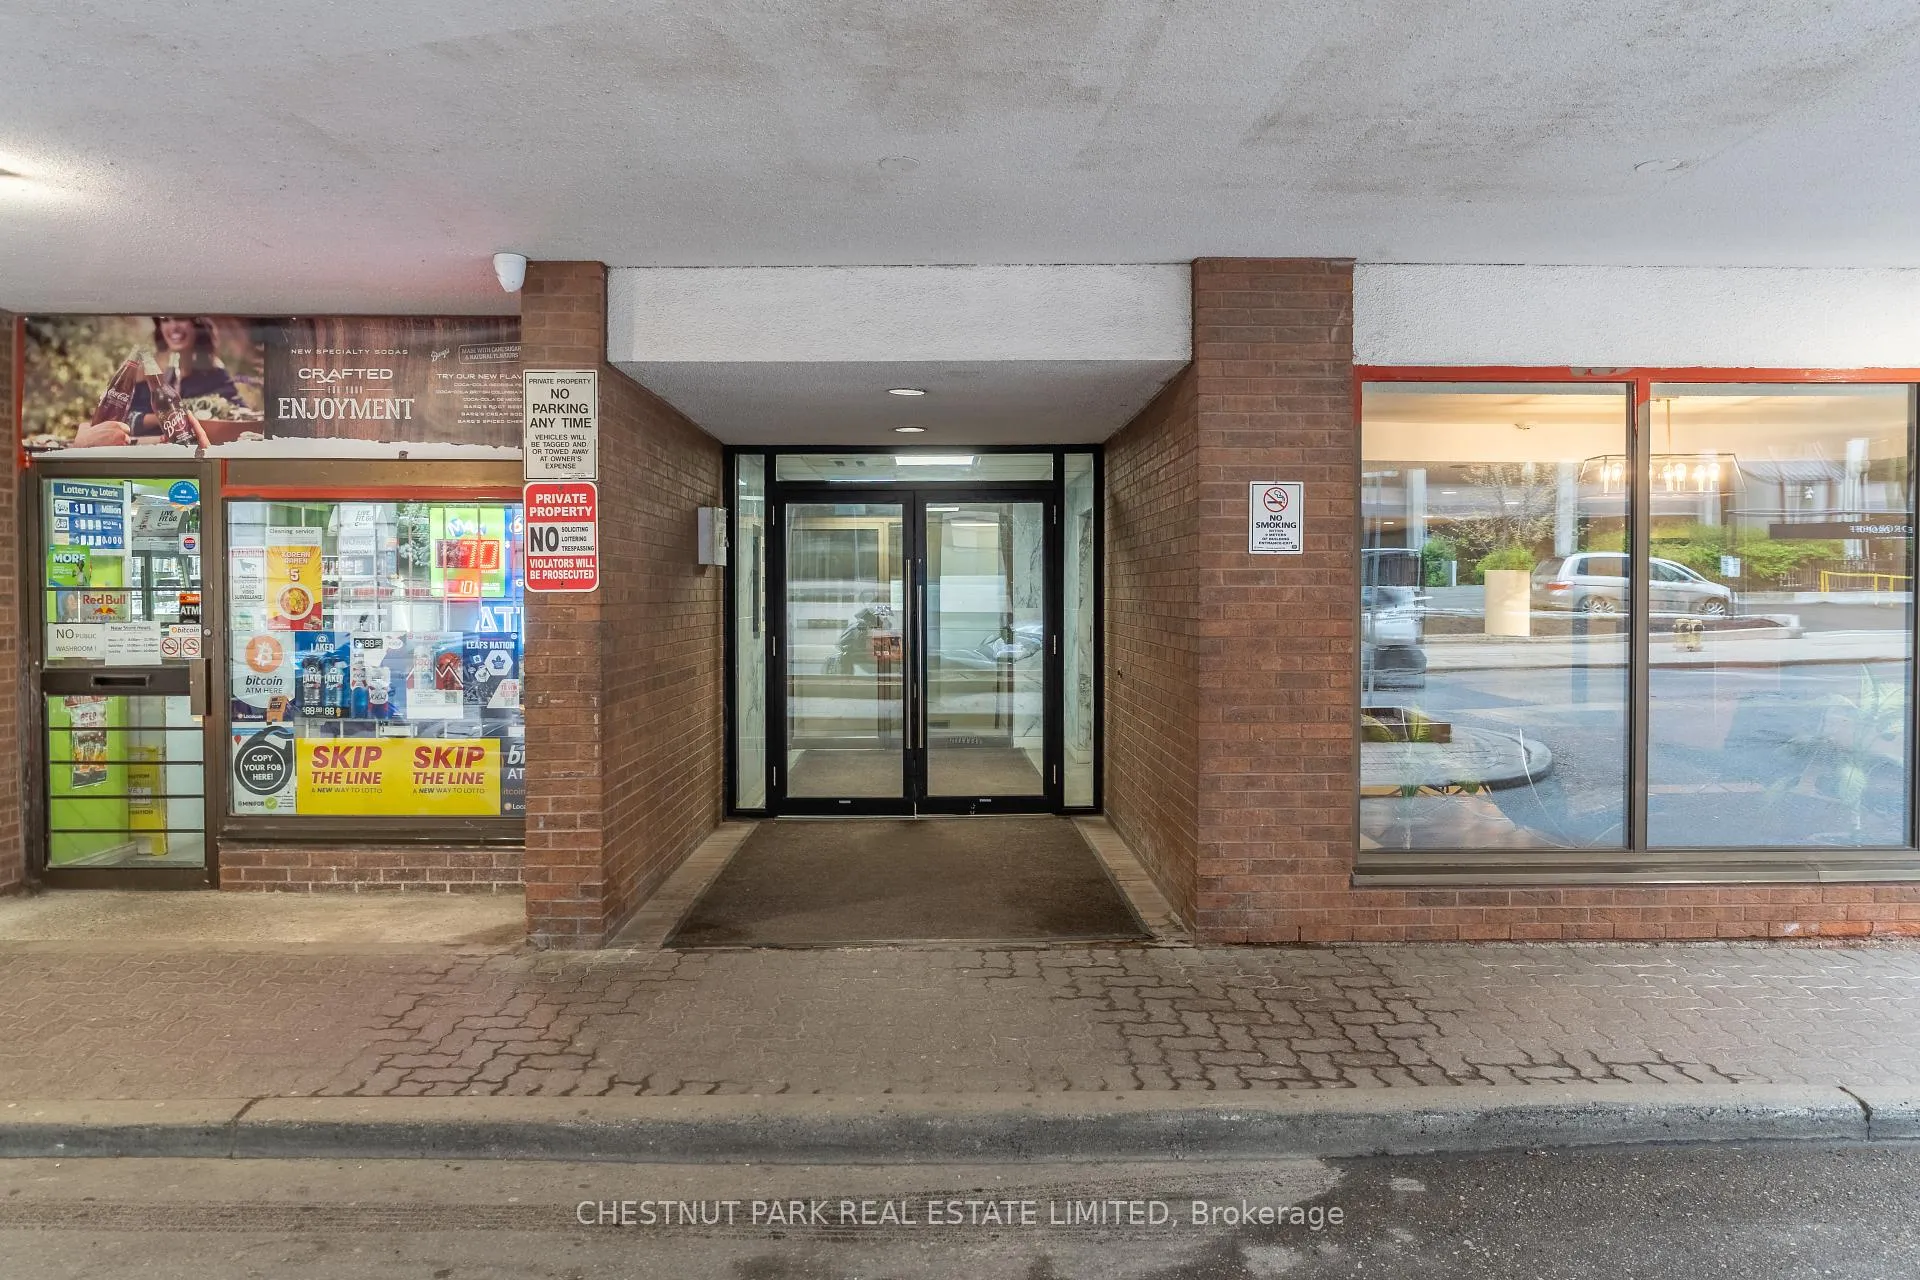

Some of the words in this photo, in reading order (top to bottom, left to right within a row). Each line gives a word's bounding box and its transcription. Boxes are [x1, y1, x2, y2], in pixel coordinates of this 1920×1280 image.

[298, 368, 394, 383] CRAFTED
[550, 388, 570, 400] NO
[277, 398, 415, 420] ENJOYMENT
[532, 403, 589, 415] PARKING
[529, 417, 557, 429] ANY
[561, 417, 592, 429] TIME
[62, 485, 90, 497] Lottery
[535, 493, 587, 504] PRIVATE
[529, 506, 593, 517] PROPERTY
[529, 526, 560, 553] NO
[529, 559, 574, 568] VIOLATORS
[576, 558, 594, 568] WILL
[529, 570, 541, 580] BE
[542, 569, 594, 580] PROSECUTED
[83, 594, 104, 605] Red
[106, 594, 126, 605] Bull
[180, 605, 199, 615] ATM
[475, 606, 524, 632] AT
[56, 629, 74, 639] NO
[310, 643, 335, 653] LAKER
[466, 641, 488, 650] LEAFS
[490, 641, 515, 650] NATION
[245, 675, 283, 686] bitcoin
[312, 745, 383, 769] SKIP
[413, 745, 485, 769] SKIP
[252, 773, 274, 781] HERE!
[311, 771, 342, 785] THE
[346, 771, 383, 785] LINE
[413, 771, 444, 785] THE
[447, 771, 484, 785] LINE
